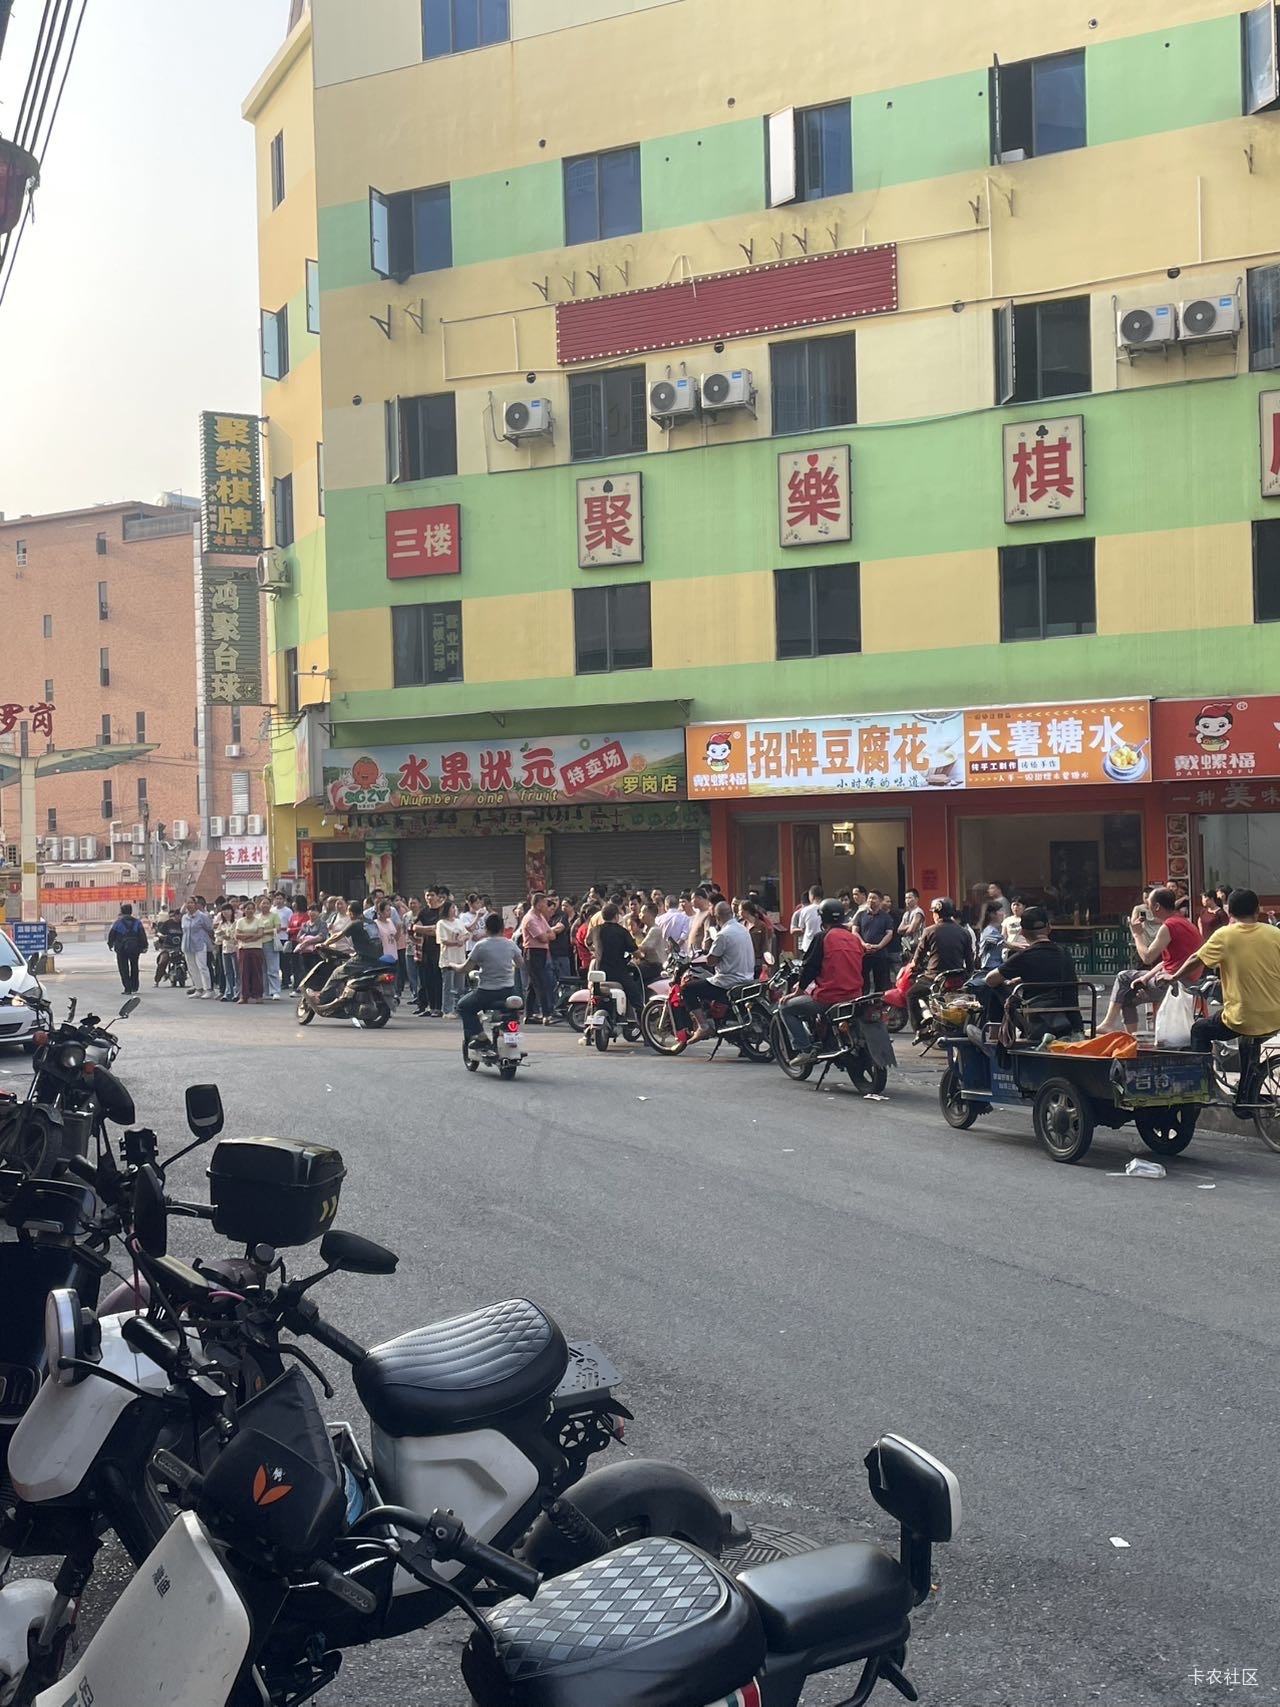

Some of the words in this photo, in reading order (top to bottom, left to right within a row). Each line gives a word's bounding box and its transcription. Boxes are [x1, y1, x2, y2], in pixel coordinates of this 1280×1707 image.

[214, 416, 253, 535] 聚樂棋牌
[1012, 437, 1074, 504] 棋
[786, 466, 842, 528] 樂
[393, 523, 452, 558] 三楼
[584, 495, 634, 550] 聚
[209, 582, 241, 702] 鸿聚台球
[750, 722, 929, 778] 招牌豆腐花
[968, 716, 1127, 758] 木薯糖水
[565, 749, 622, 787] 特卖场
[1173, 752, 1256, 771] 戴螺福
[1176, 769, 1254, 777] DAILUOFU
[400, 794, 459, 808] Number
[477, 793, 504, 805] one
[520, 789, 559, 803] fruit
[623, 775, 679, 795] 罗岗店
[836, 775, 920, 790] 小时候的味道
[1172, 783, 1280, 808] 一种美味
[225, 846, 268, 864] 李胜利
